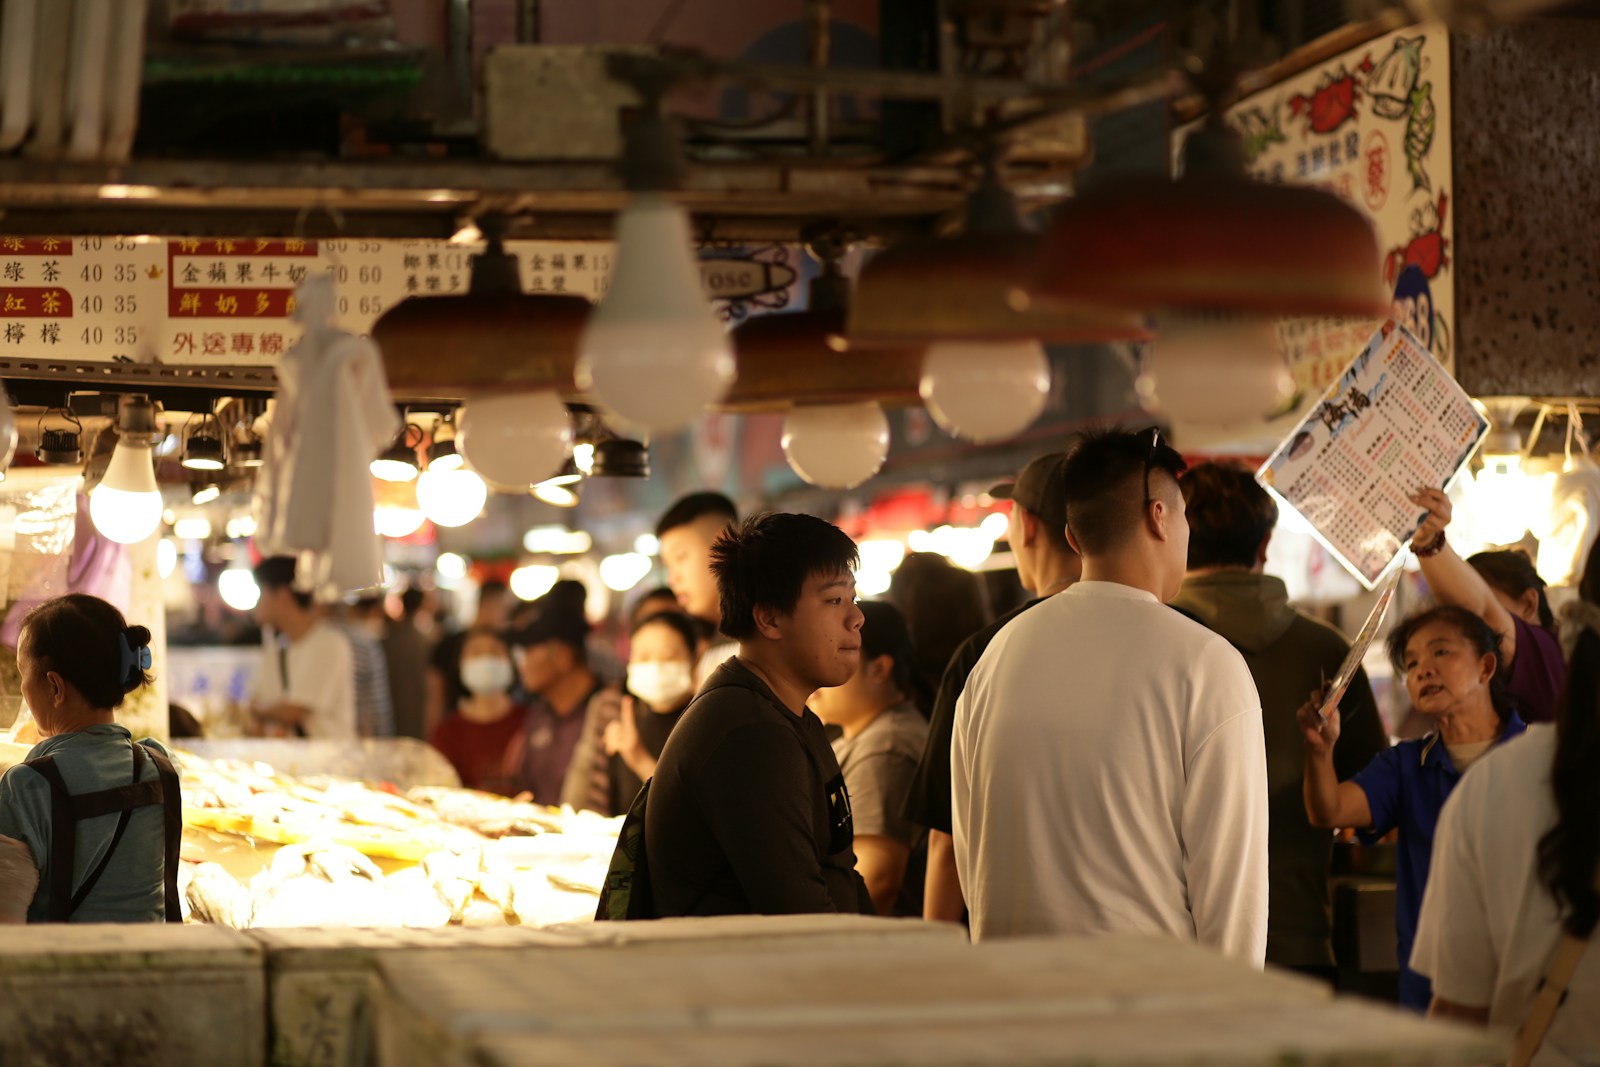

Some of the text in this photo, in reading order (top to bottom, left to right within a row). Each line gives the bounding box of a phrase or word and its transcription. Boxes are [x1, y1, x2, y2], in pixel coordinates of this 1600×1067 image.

[80, 237, 102, 252] 40
[4, 260, 137, 282] 綠茶 40 35
[359, 265, 381, 284] 60
[4, 291, 137, 314] 紅茶 40 35
[359, 296, 382, 315] 65
[4, 322, 137, 344] 檸檬 40 35
